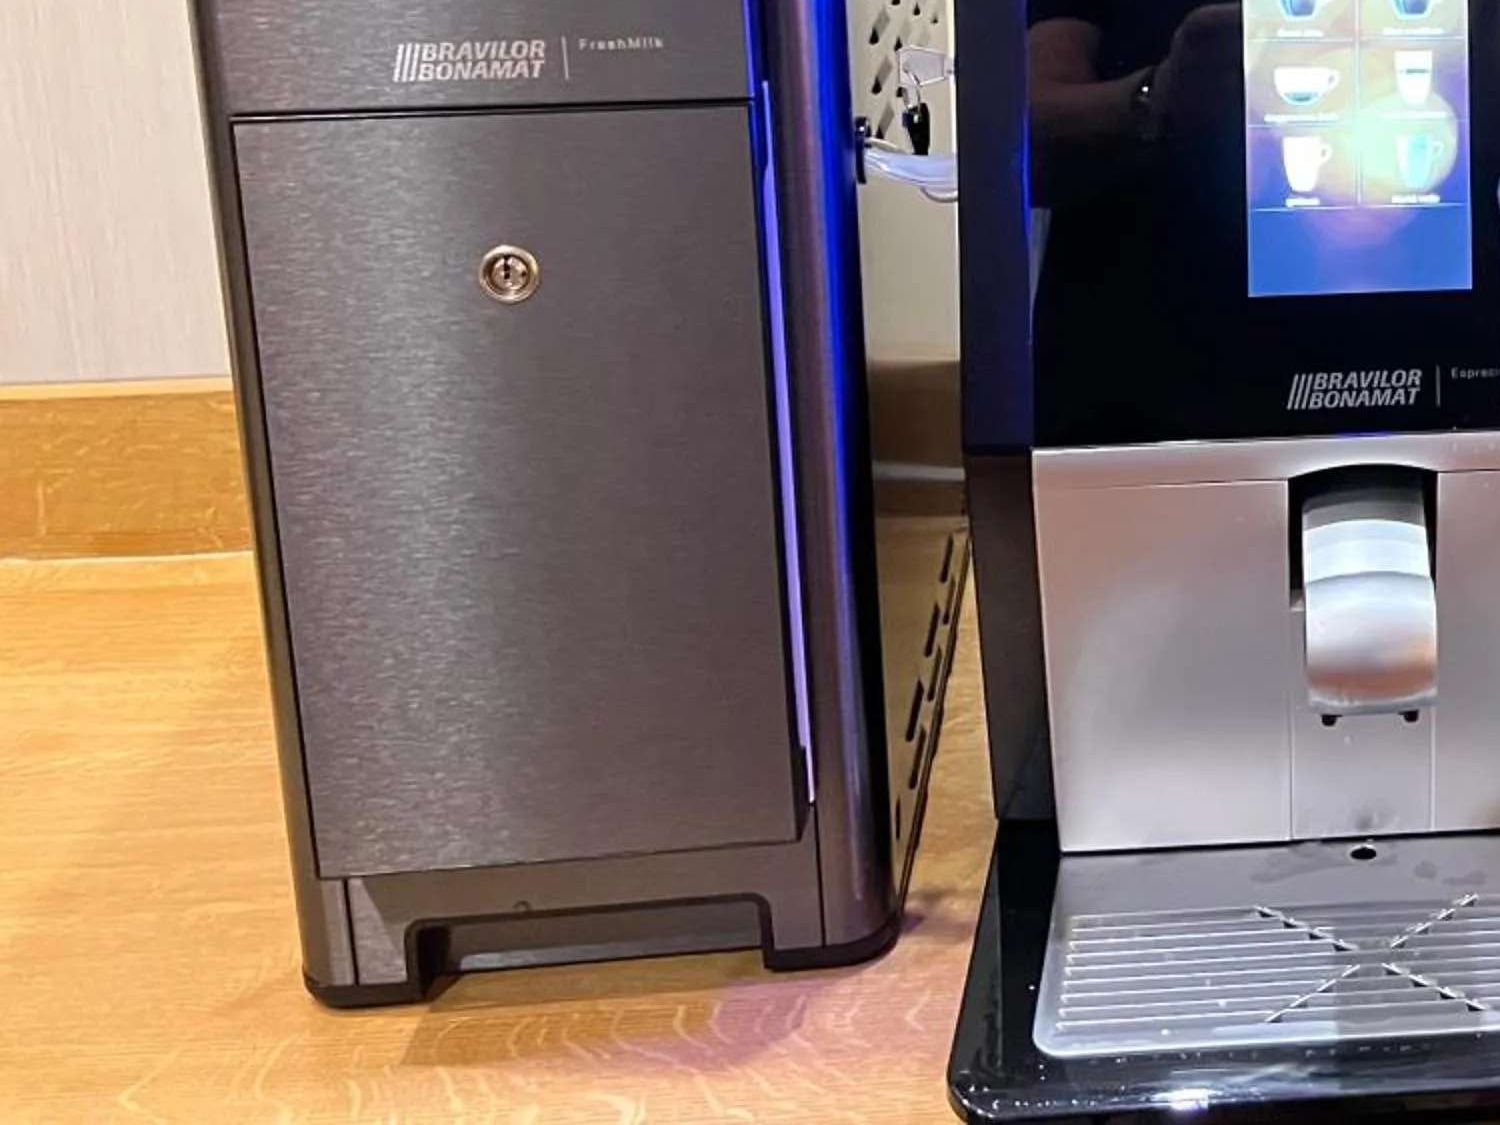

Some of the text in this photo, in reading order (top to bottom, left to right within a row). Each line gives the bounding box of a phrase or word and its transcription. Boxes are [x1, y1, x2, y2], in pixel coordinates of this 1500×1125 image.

[421, 40, 545, 62] BRAVILOR
[417, 59, 543, 82] BONAMAT
[1313, 368, 1422, 390] BRAVILOR
[1308, 387, 1420, 409] BONAMAT
